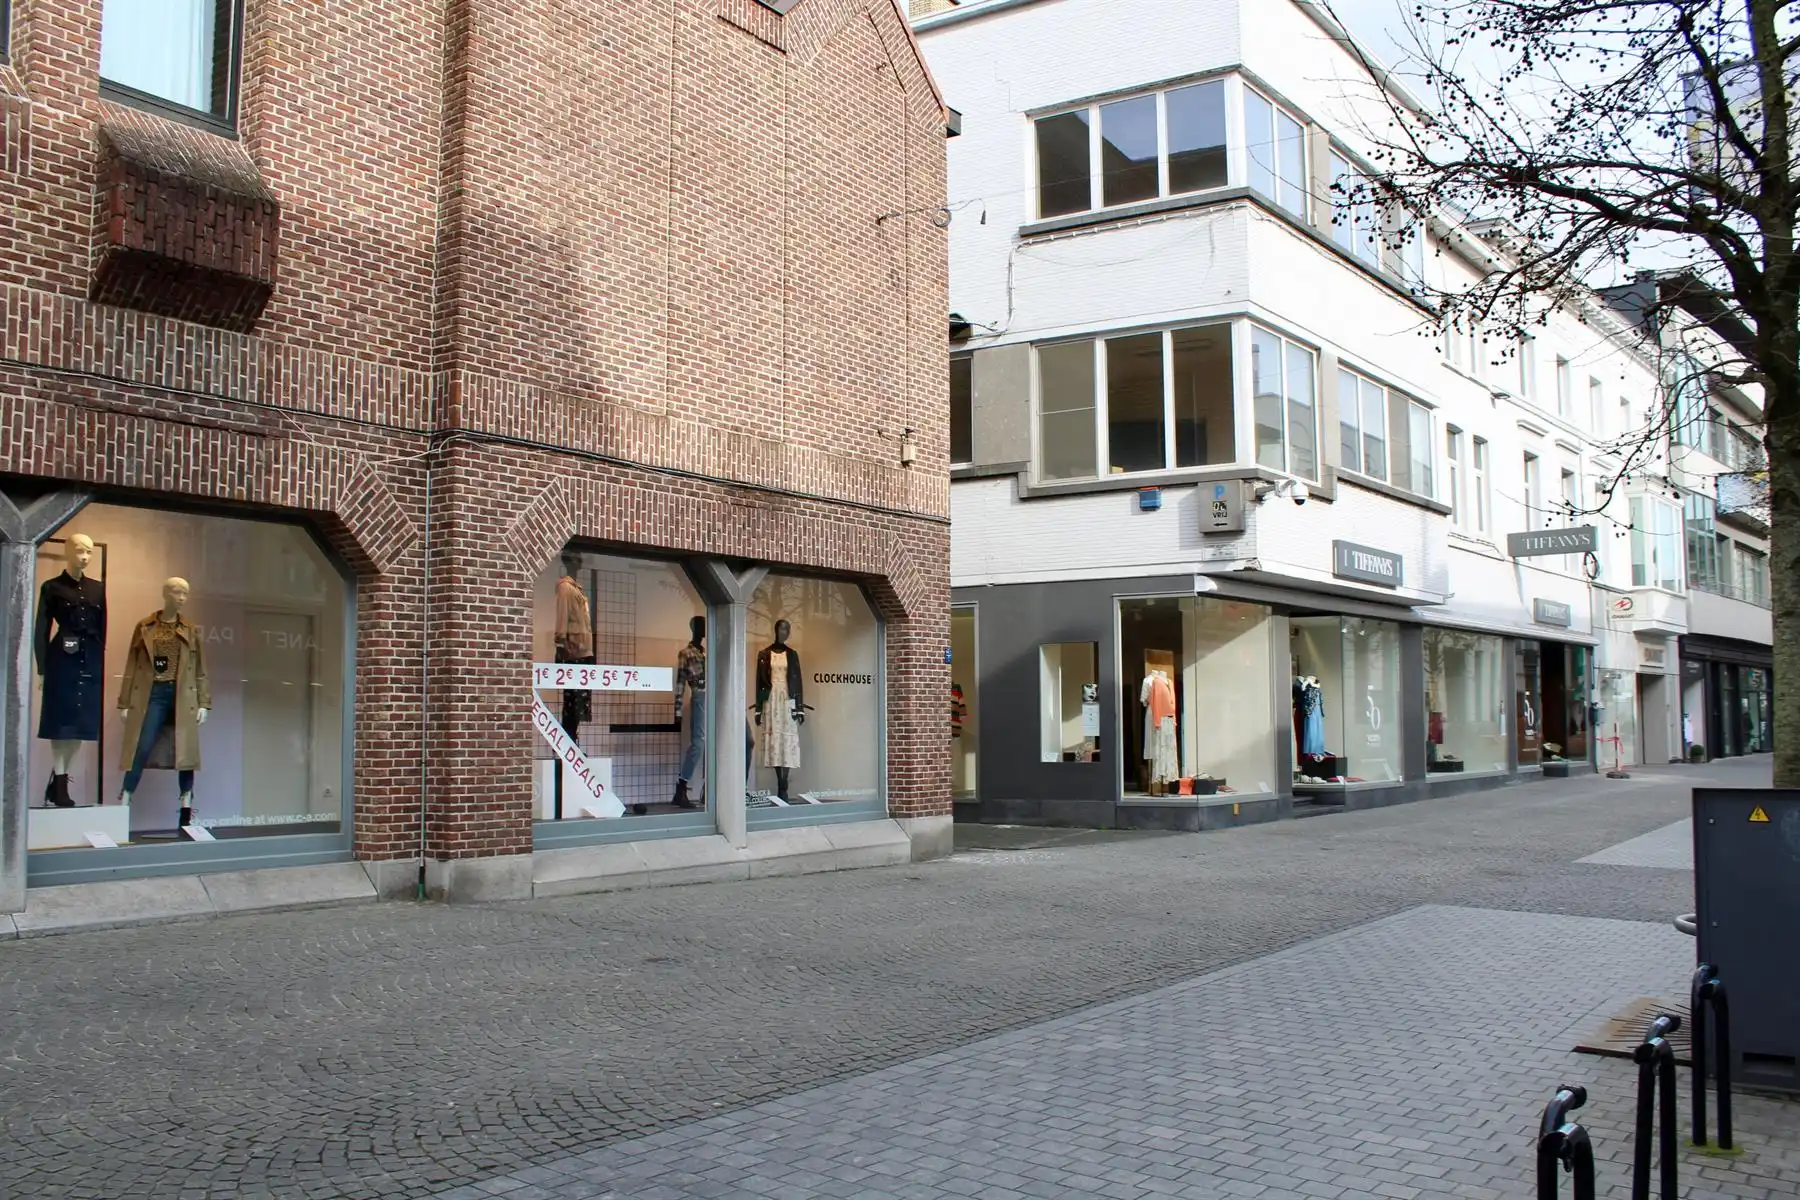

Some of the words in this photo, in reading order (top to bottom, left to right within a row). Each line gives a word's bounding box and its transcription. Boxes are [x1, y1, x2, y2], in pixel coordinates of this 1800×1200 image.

[535, 667, 550, 685] 1€
[555, 668, 573, 686] 2€
[579, 669, 597, 687] 3€
[602, 670, 618, 687] 5€
[623, 670, 639, 687] 7€
[813, 672, 872, 685] CLOCKHOUSE
[565, 746, 605, 799] DEALS
[254, 814, 266, 824] at
